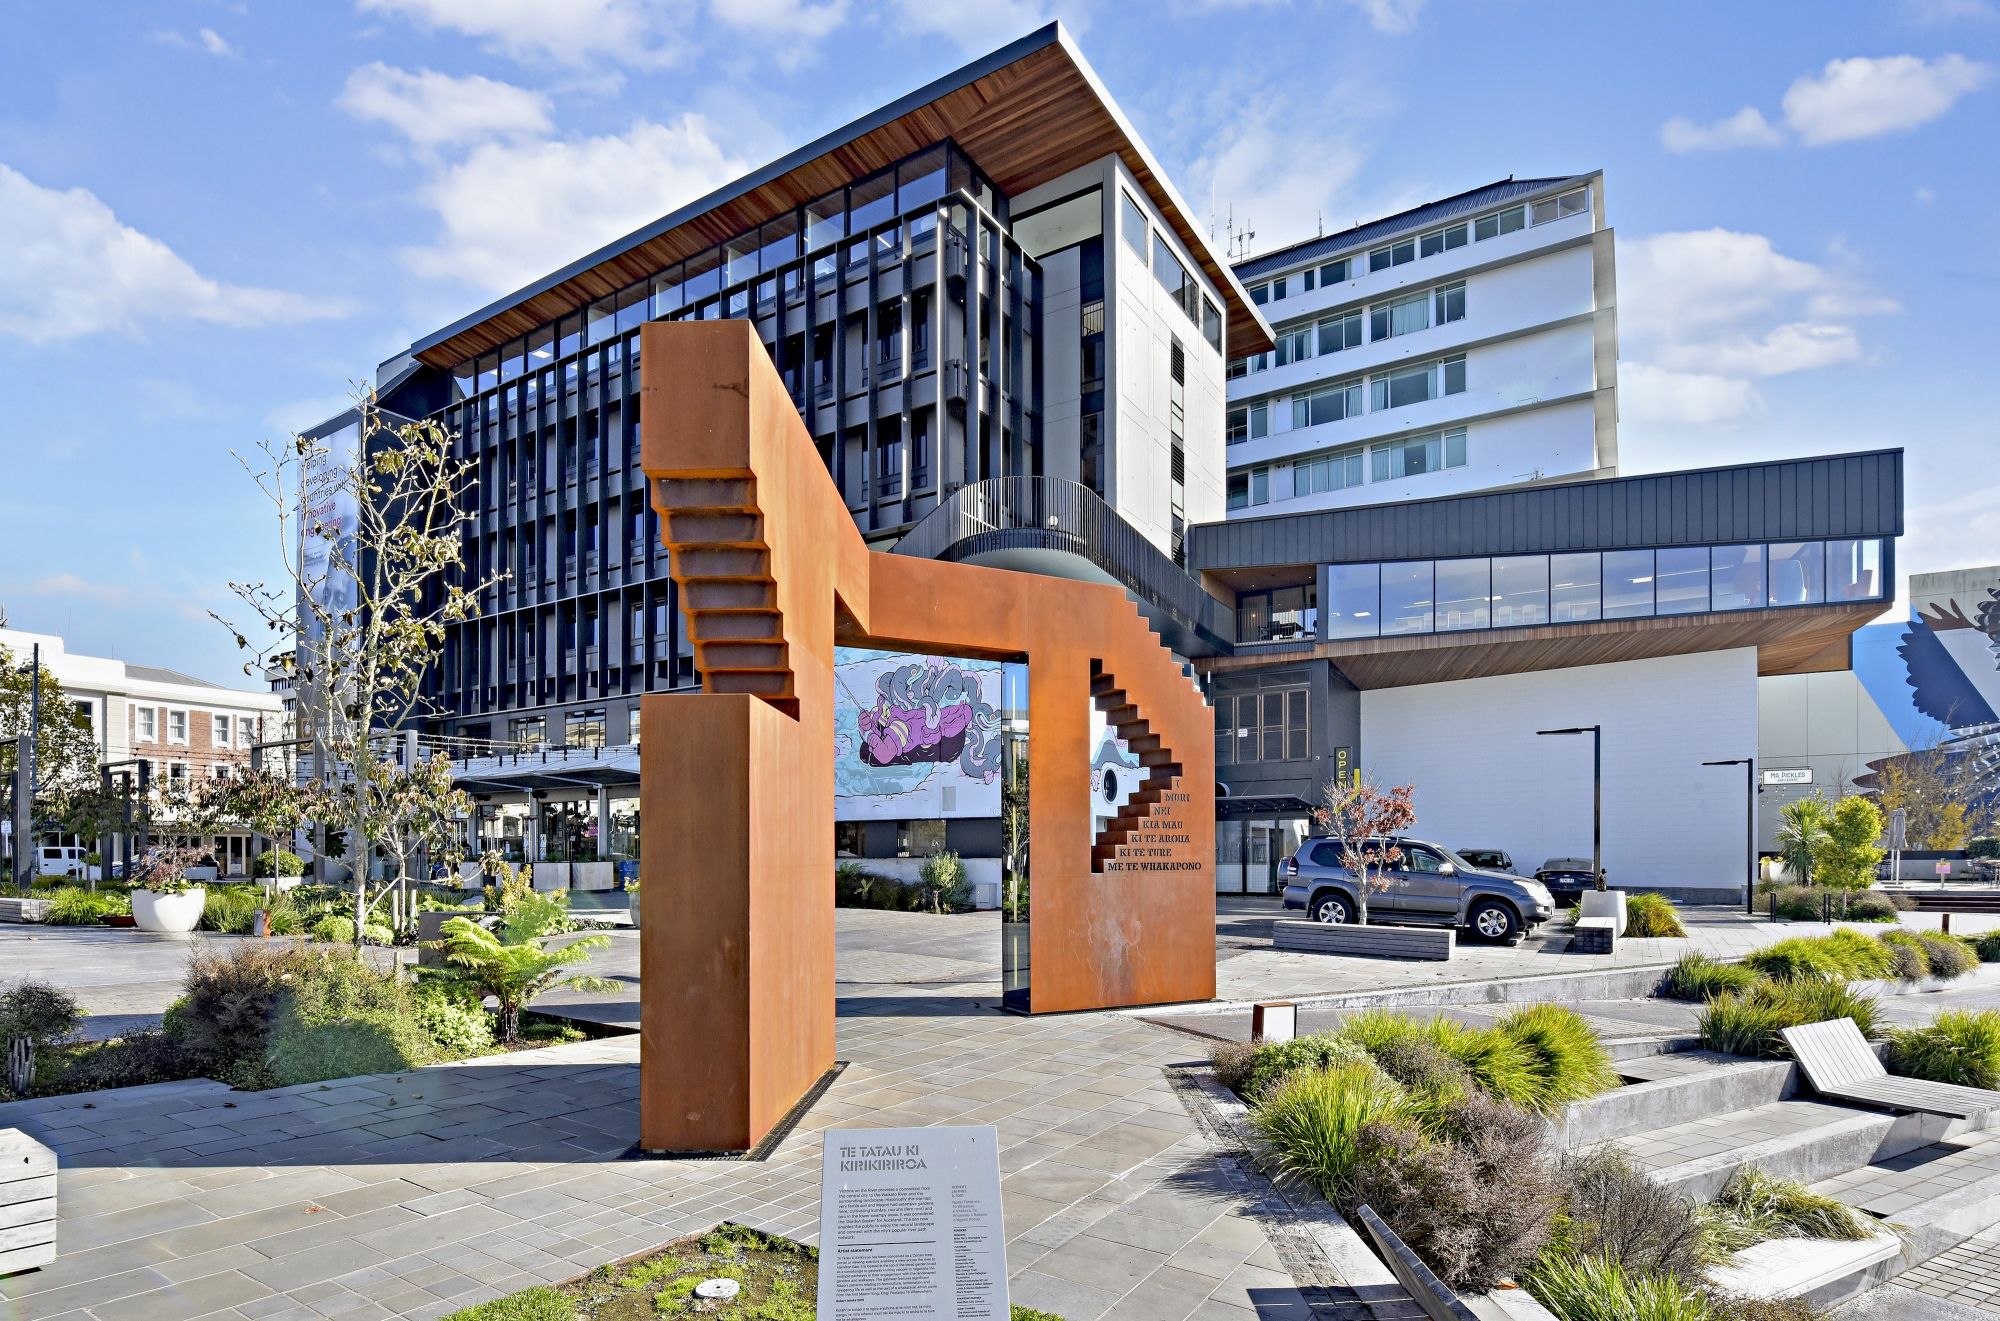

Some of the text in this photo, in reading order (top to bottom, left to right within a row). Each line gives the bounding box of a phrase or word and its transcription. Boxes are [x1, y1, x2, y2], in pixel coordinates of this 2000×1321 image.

[1165, 793, 1190, 802] MURI
[1153, 807, 1170, 815] NEI
[1143, 821, 1183, 829] KIA MAU
[1131, 835, 1190, 843] KI TE AROHA
[1120, 849, 1172, 857] KI TE TURE
[1108, 862, 1201, 871] ME TE WHAKAPONO
[840, 1145, 919, 1157] TE TATAU KI
[840, 1158, 927, 1172] KIRIKIRIROA
